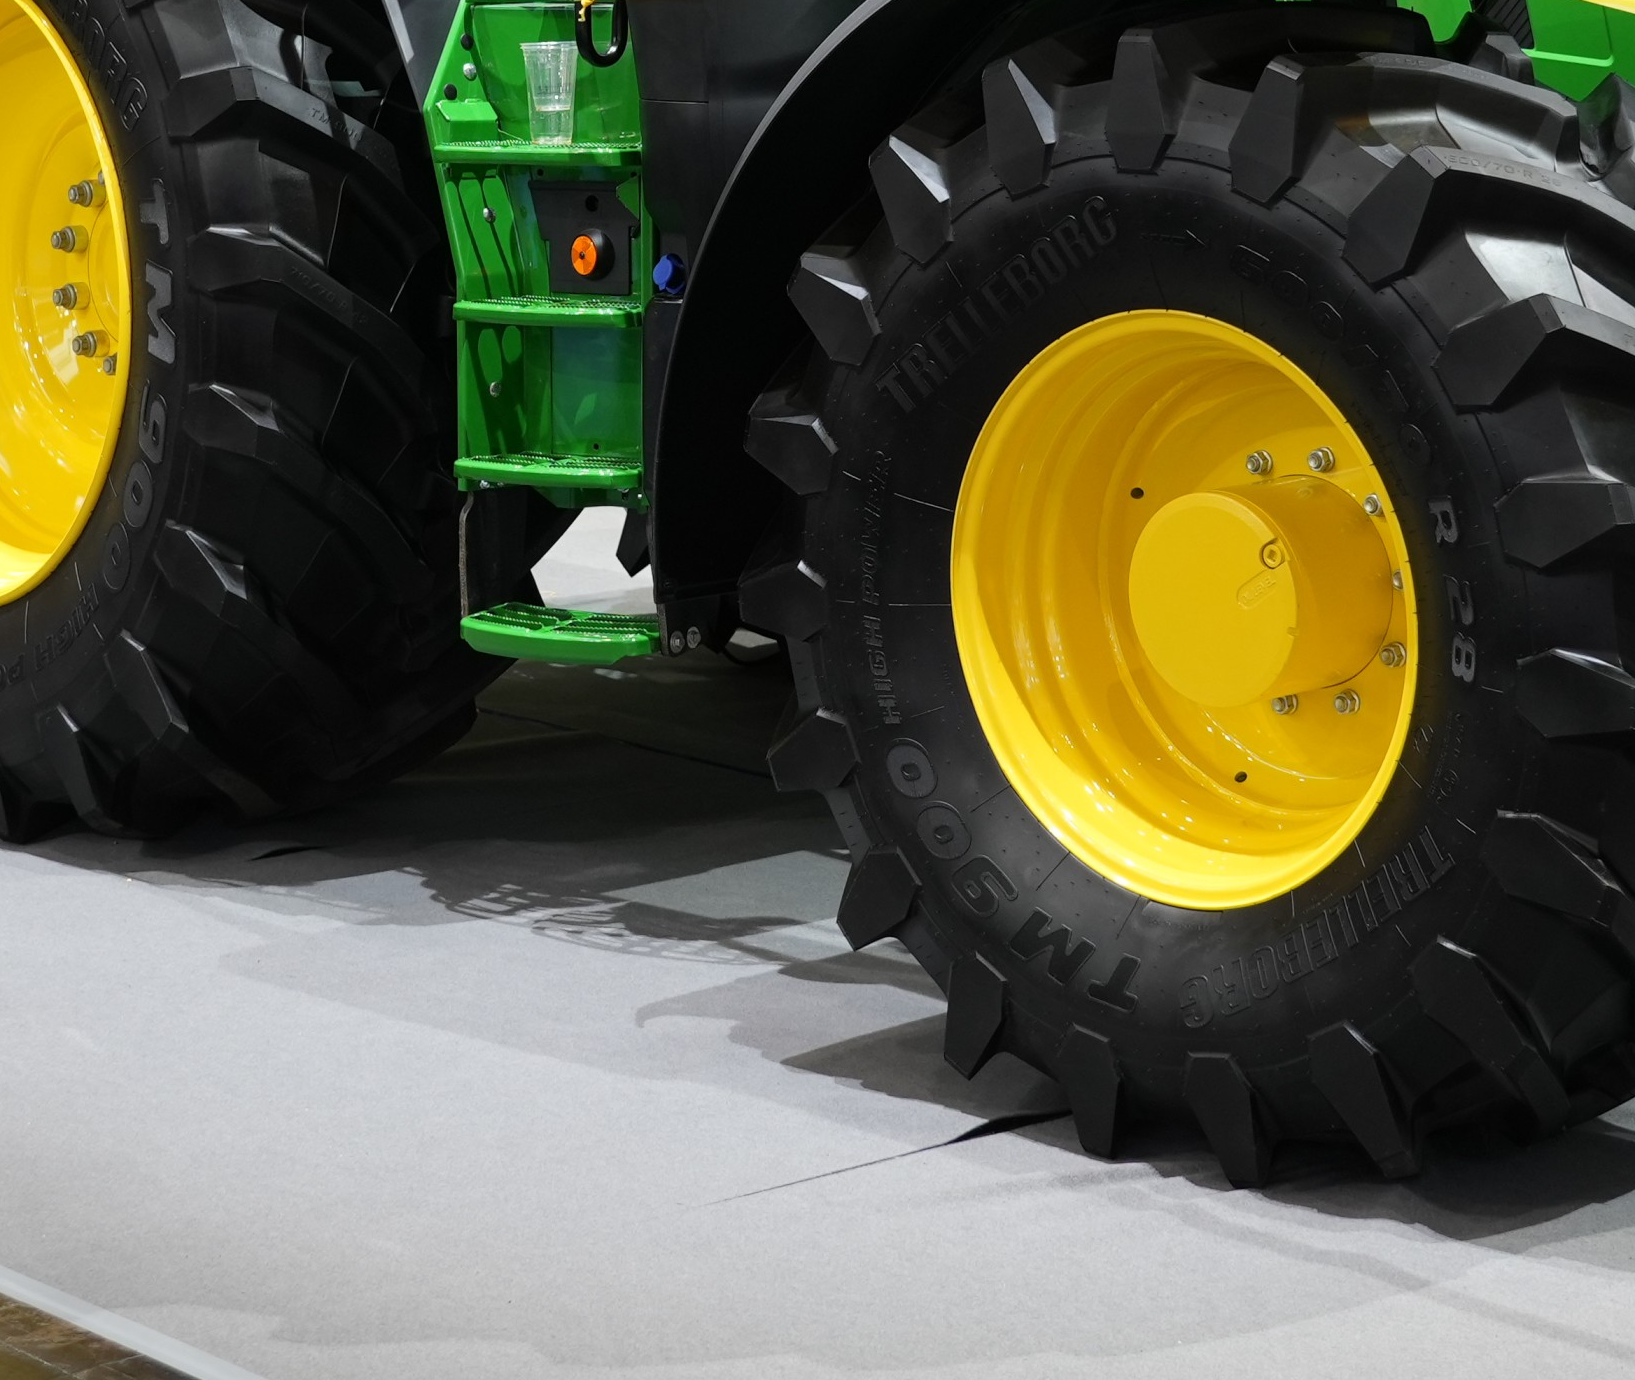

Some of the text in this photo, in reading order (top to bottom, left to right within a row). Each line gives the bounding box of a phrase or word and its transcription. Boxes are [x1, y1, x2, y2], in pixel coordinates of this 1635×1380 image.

[139, 177, 178, 365] TM
[874, 194, 1119, 415] TRELLEBORG
[862, 616, 903, 727] HIGH
[885, 737, 1141, 1014] TM 900
